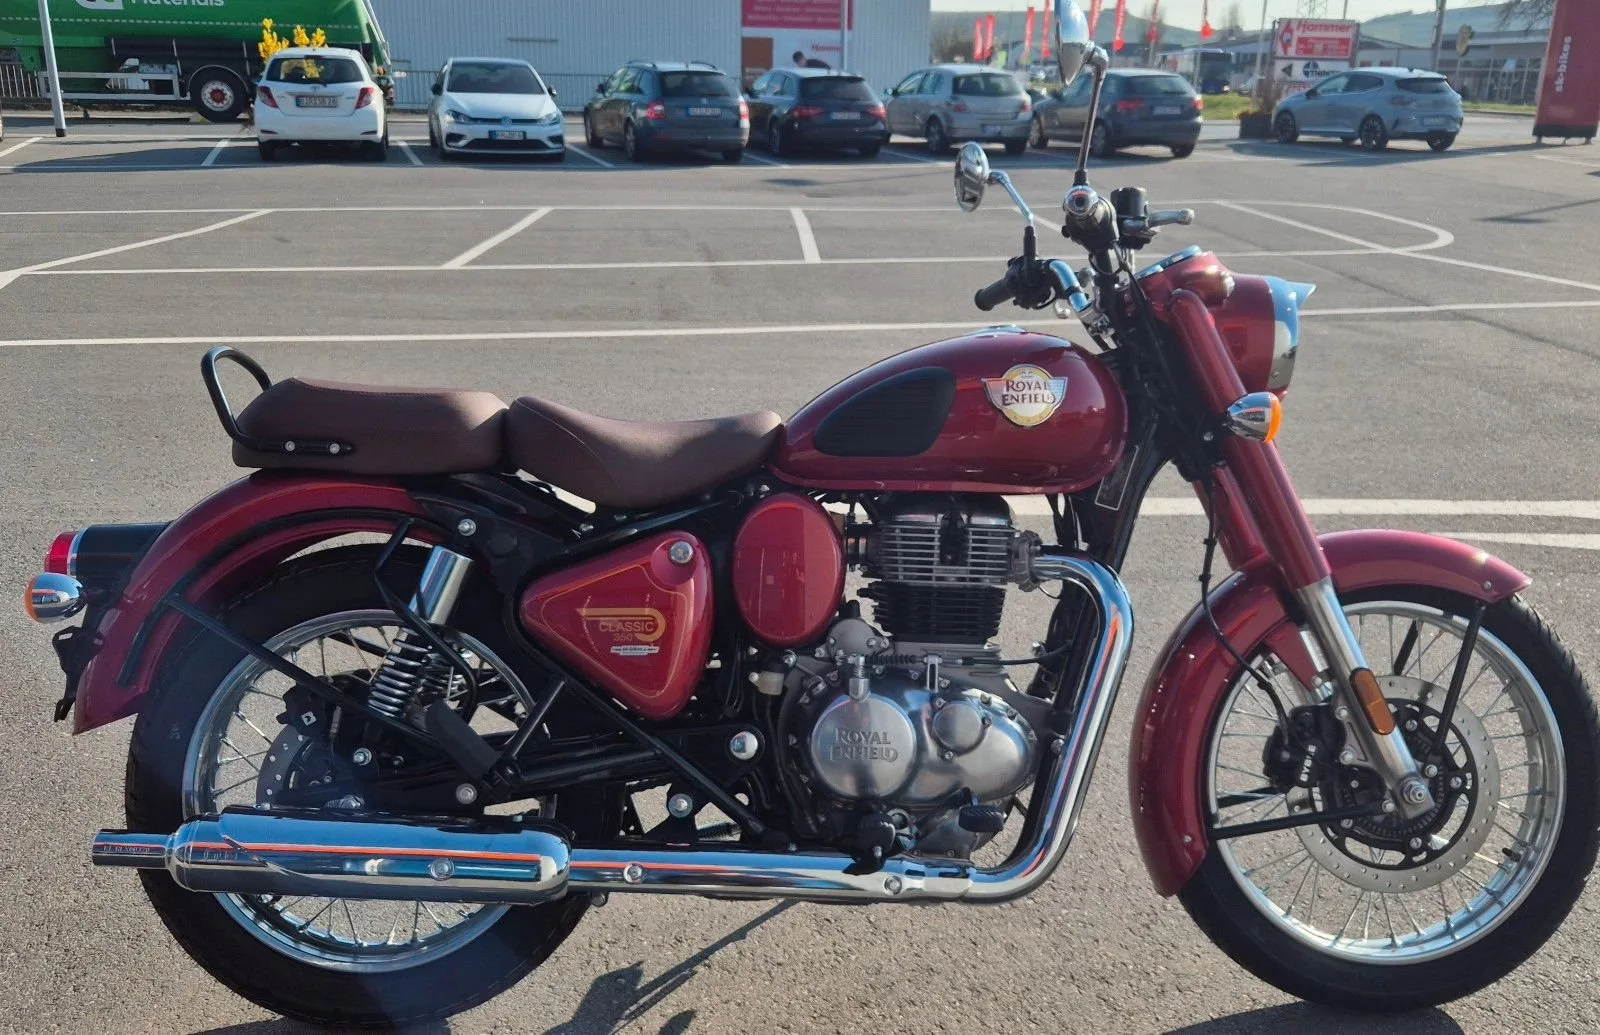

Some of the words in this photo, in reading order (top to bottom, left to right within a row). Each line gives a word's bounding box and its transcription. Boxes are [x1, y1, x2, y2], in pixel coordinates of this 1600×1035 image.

[1555, 35, 1572, 92] sk-bikes
[1005, 380, 1050, 393] ROYAL
[1001, 393, 1056, 406] ENFIELD
[599, 621, 654, 633] CLASSIC
[613, 632, 633, 642] 350
[835, 728, 891, 745] ROYAL
[830, 746, 898, 763] ENFIELD
